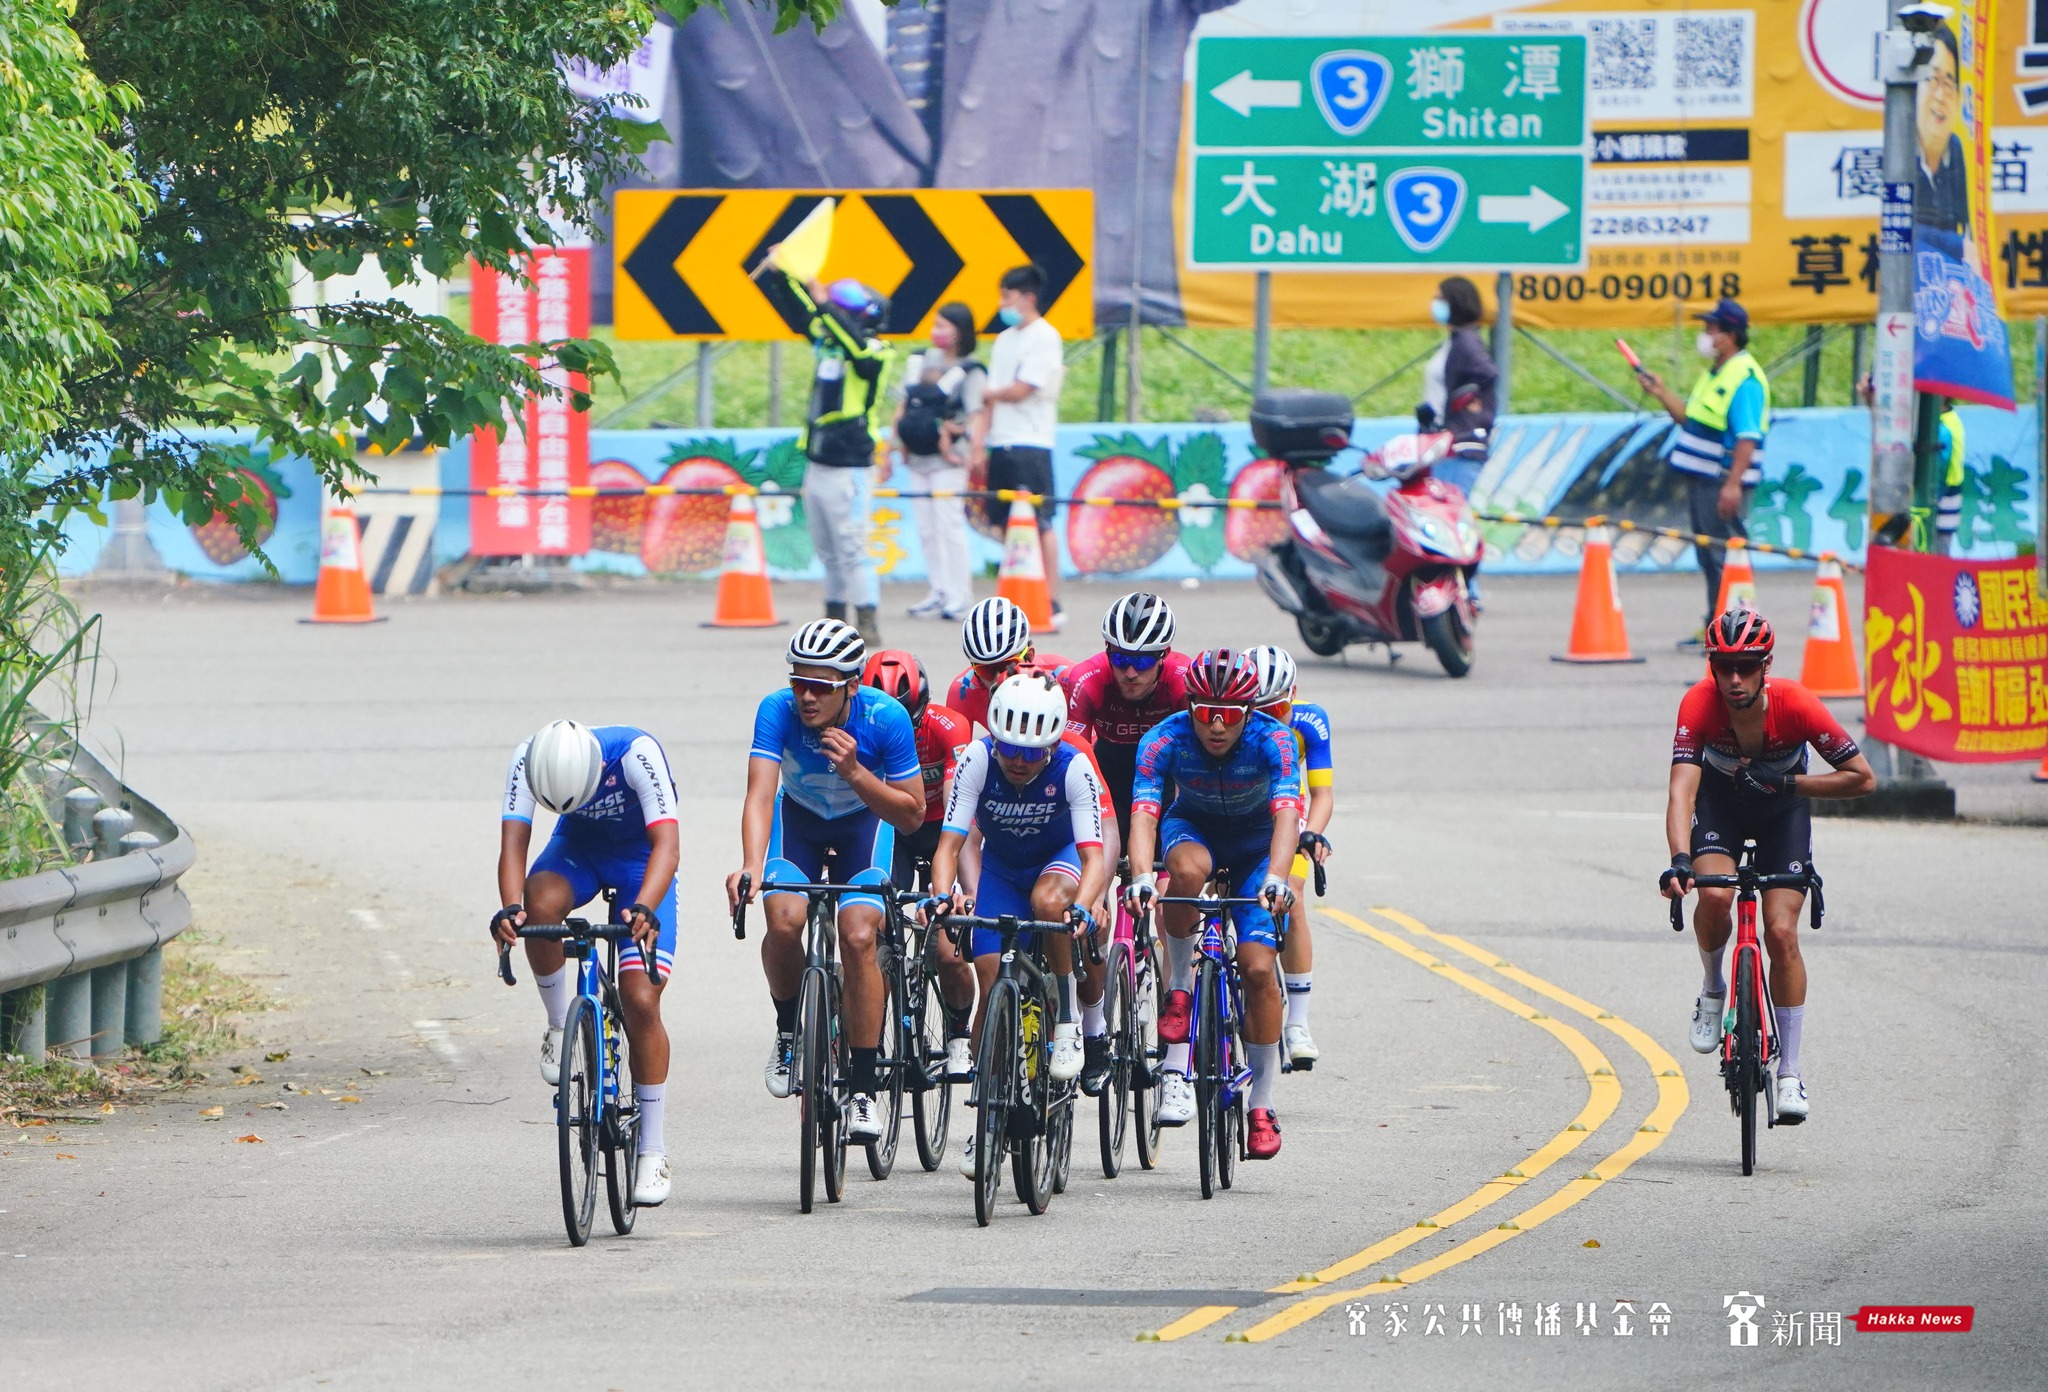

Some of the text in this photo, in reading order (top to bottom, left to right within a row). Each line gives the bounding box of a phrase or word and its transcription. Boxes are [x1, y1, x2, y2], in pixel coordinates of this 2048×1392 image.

[1332, 66, 1369, 109] 3
[1406, 44, 1561, 100] 獅潭
[1422, 107, 1543, 139] Shitan
[1220, 161, 1377, 217] 大湖
[1407, 182, 1442, 226] 3
[1250, 224, 1343, 255] Dahu
[984, 799, 1057, 816] CHINESE
[991, 814, 1051, 826] TAIPEI
